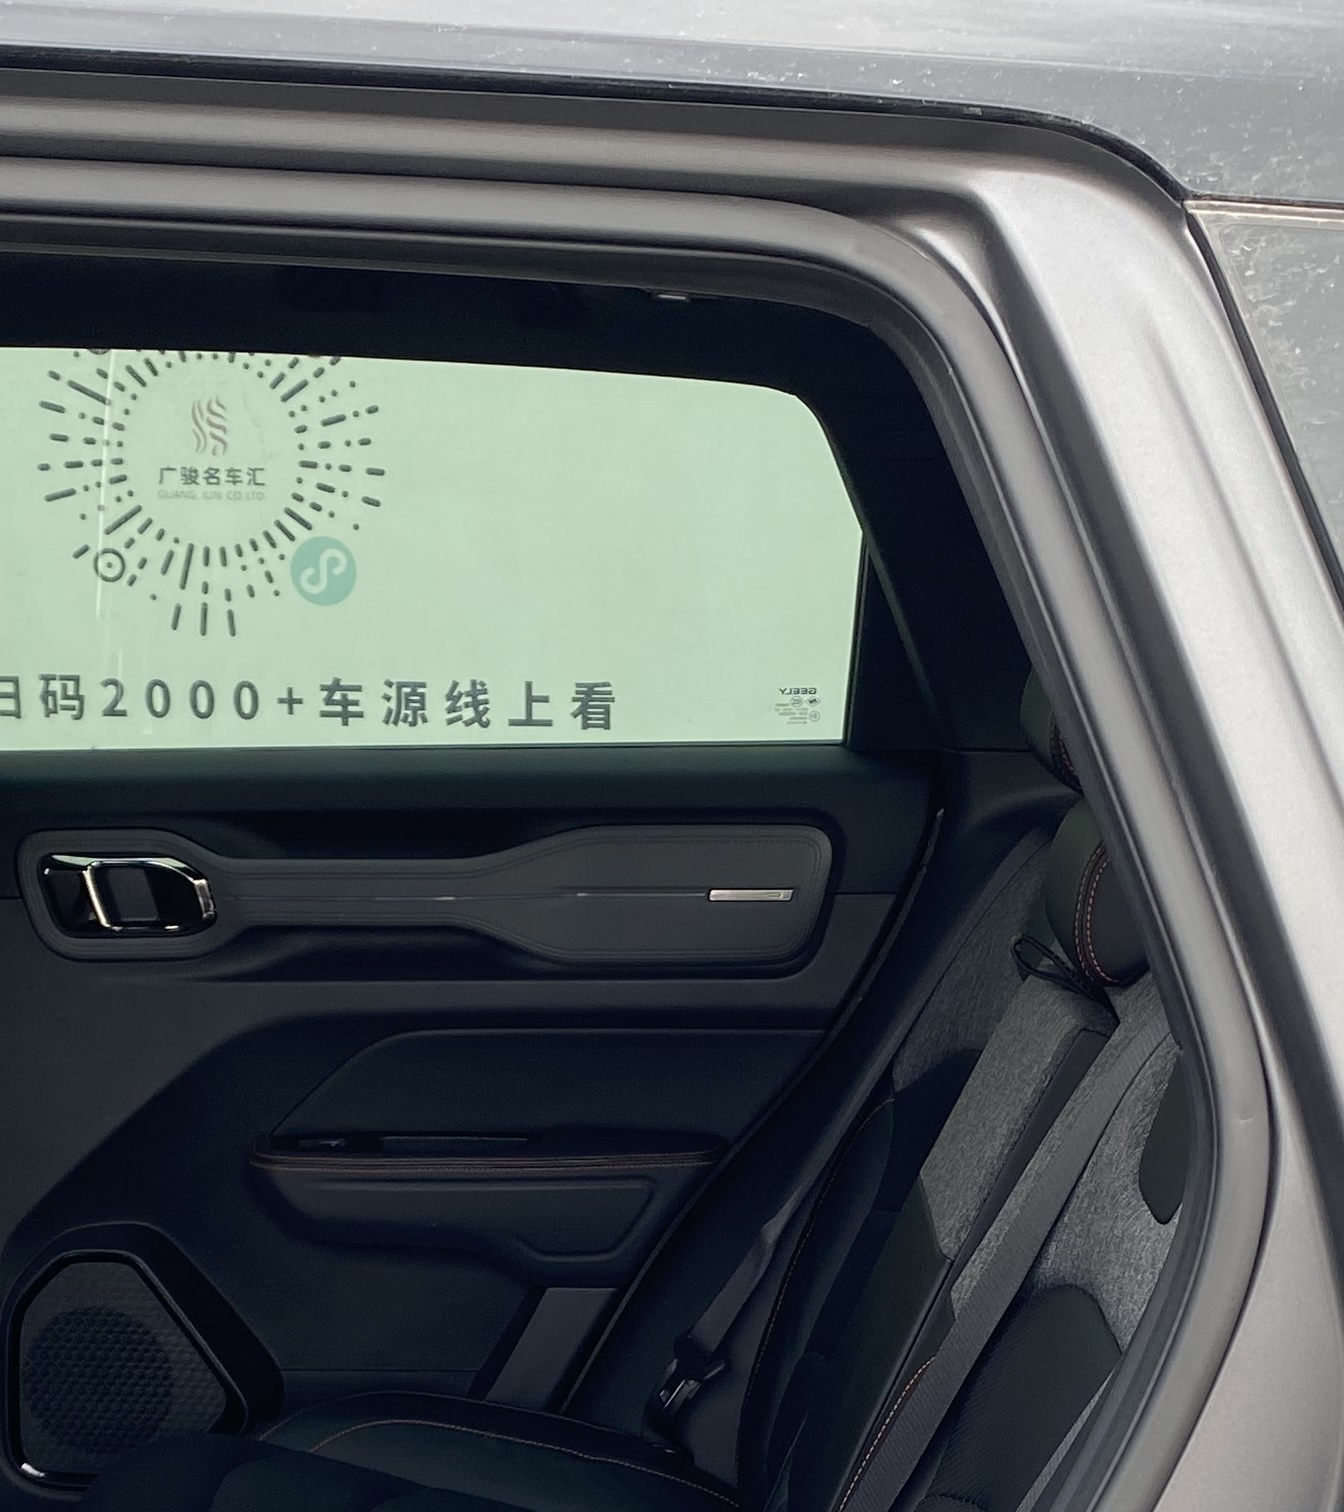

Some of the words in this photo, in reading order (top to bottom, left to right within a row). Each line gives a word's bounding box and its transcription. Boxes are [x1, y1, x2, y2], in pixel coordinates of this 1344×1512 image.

[158, 466, 265, 486] 广骏名车汇
